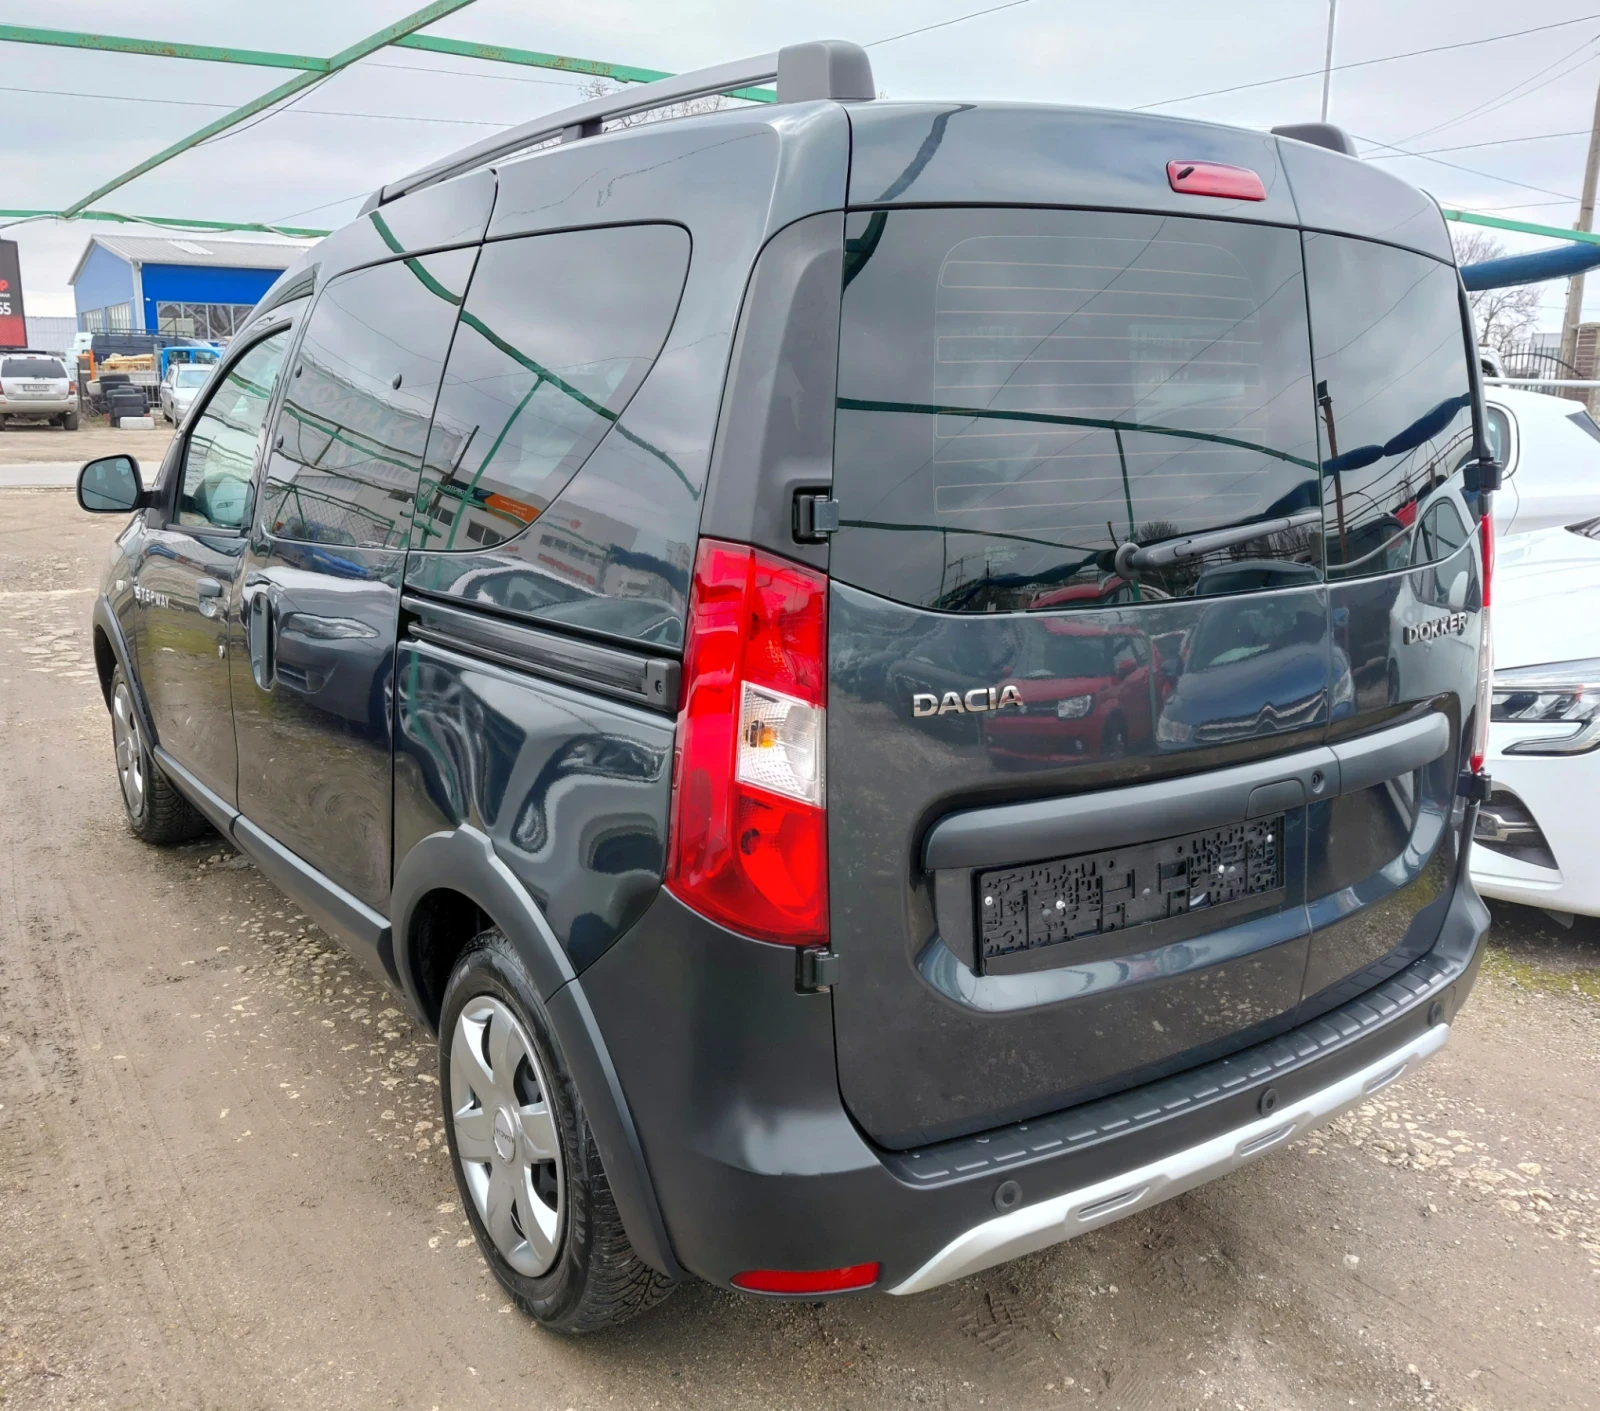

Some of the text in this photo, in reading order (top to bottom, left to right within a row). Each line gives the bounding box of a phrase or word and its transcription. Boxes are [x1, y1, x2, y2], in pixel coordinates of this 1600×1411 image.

[134, 585, 169, 608] STEPWAY
[1404, 611, 1467, 645] DOKKER
[912, 684, 1024, 718] DACIA
